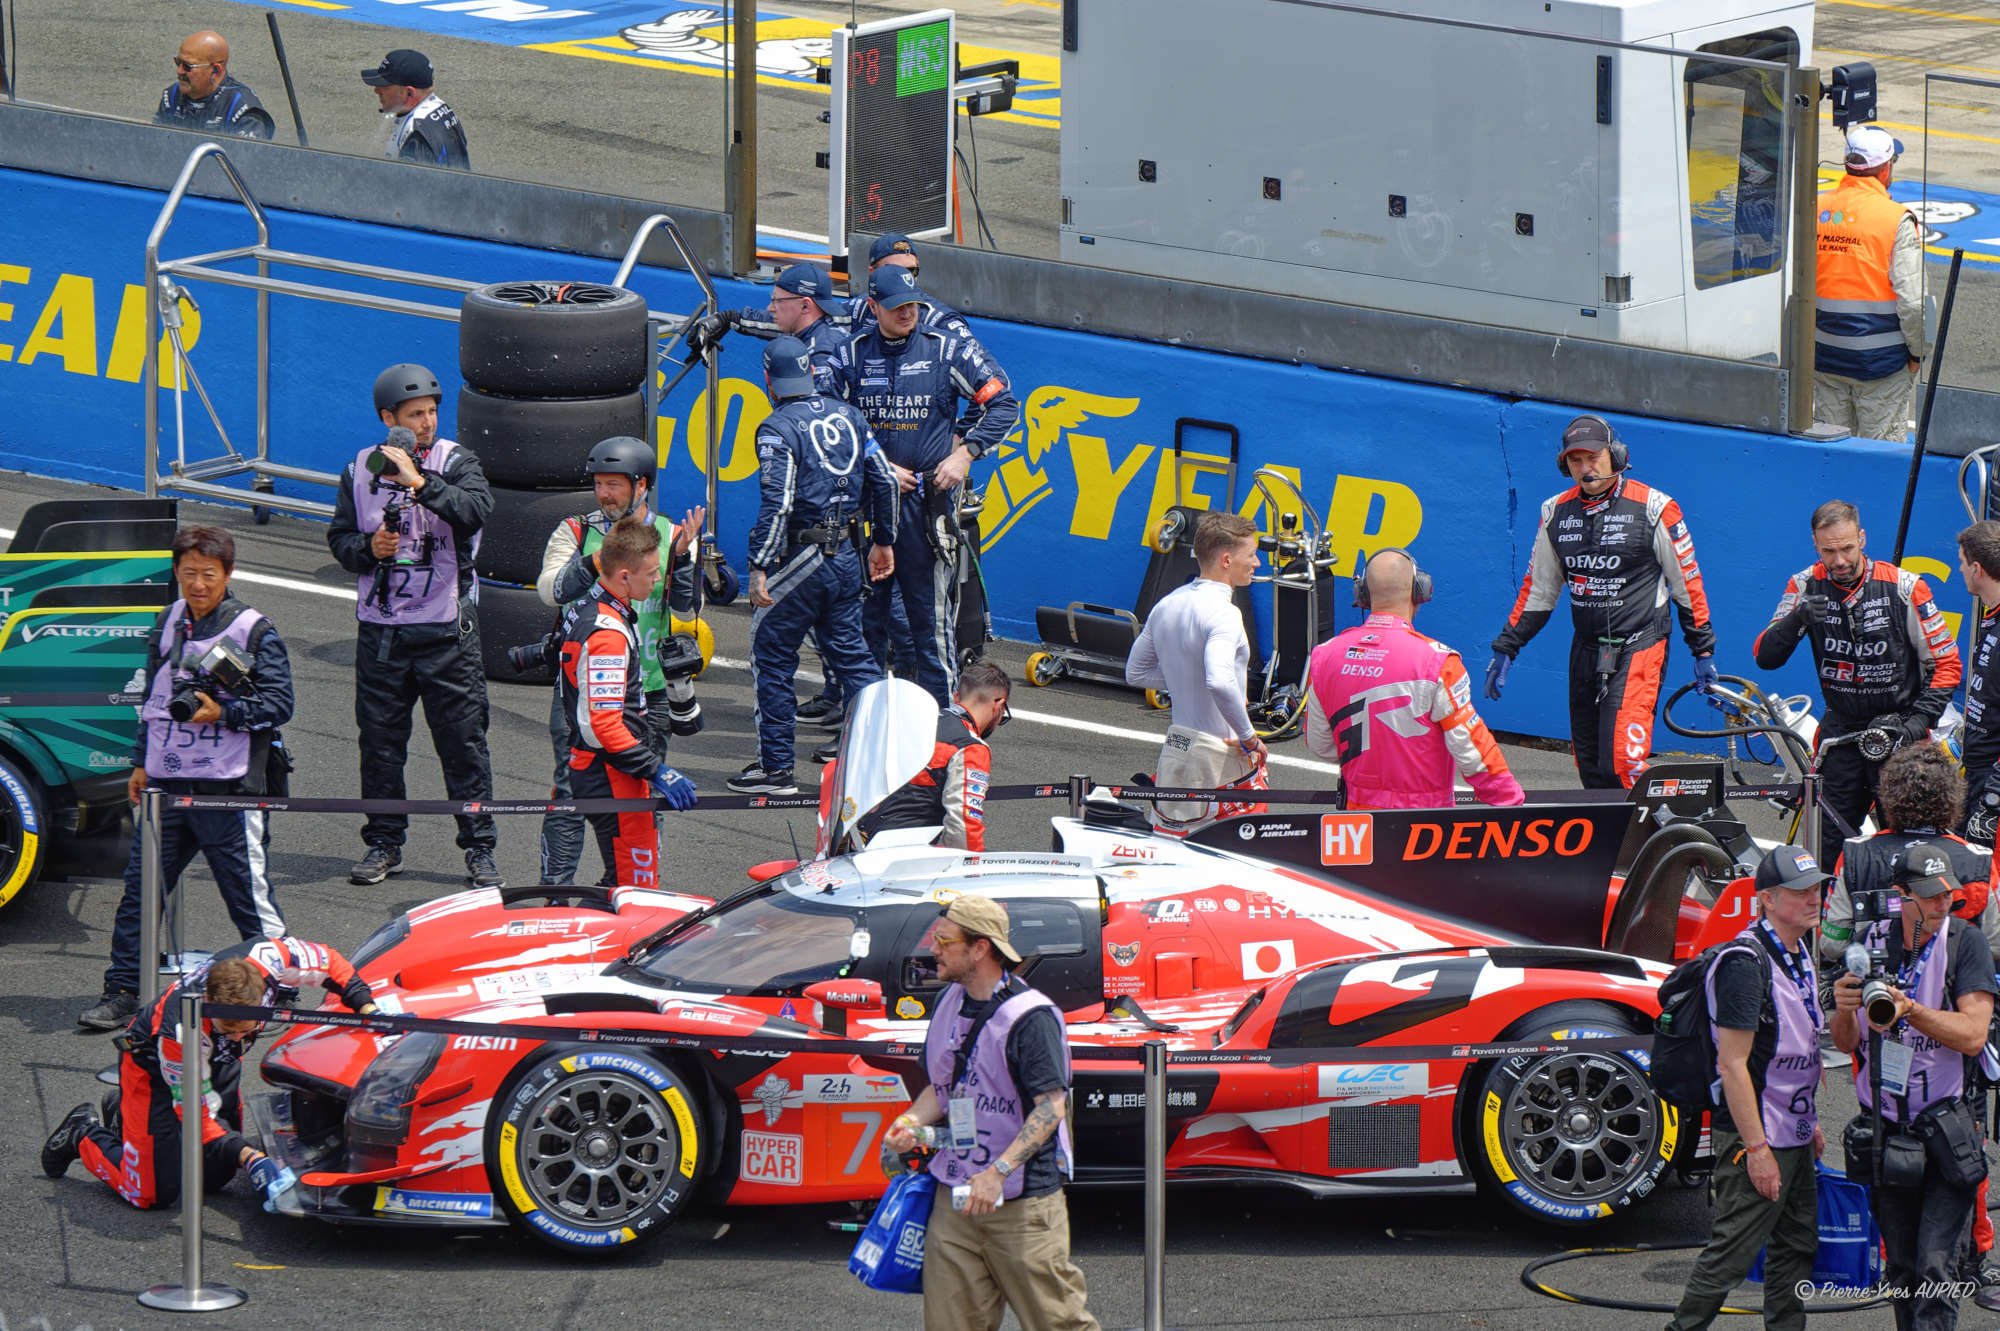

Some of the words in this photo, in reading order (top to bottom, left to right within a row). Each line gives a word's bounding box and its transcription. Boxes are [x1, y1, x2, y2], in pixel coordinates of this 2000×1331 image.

[900, 35, 945, 79] #63
[1822, 235, 1862, 246] MARSHAL
[858, 395, 882, 407] THE
[886, 395, 932, 407] HEART
[861, 408, 876, 418] OF
[878, 407, 929, 419] RACING
[896, 423, 918, 431] DRIVE
[1559, 515, 1583, 530] FUJITSU
[1565, 555, 1621, 570] DENSO
[1587, 576, 1627, 584] TOYOTA
[21, 624, 151, 643] VALKYRIE
[1824, 637, 1888, 657] DENSO
[1341, 663, 1384, 678] DENSO
[1858, 662, 1897, 671] TOYOTA
[1854, 675, 1892, 684] Racing
[157, 718, 223, 748] 754
[1761, 789, 1789, 797] Racing
[1637, 806, 1649, 823] 7
[1259, 823, 1291, 831] JAPAN
[1261, 829, 1308, 838] AIRLINES
[1325, 823, 1368, 856] HY
[1402, 818, 1594, 861] DENSO
[1112, 843, 1158, 859] ZENT
[1018, 858, 1049, 866] GAZOO
[1050, 859, 1081, 867] Racing
[826, 991, 857, 1003] Mobil
[453, 1035, 518, 1051] AISIN
[591, 1055, 665, 1086] MICHELIN
[1336, 1064, 1410, 1083] WEC
[820, 1078, 852, 1095] 24h
[1487, 1098, 1498, 1112] M
[503, 1128, 515, 1143] M
[841, 1111, 883, 1175] 7
[746, 1136, 797, 1155] HYPER
[745, 1152, 797, 1179] CAR
[408, 1197, 483, 1212] MICHELIN
[1514, 1186, 1584, 1218] MICHELIN
[533, 1214, 607, 1245] MICHELIN
